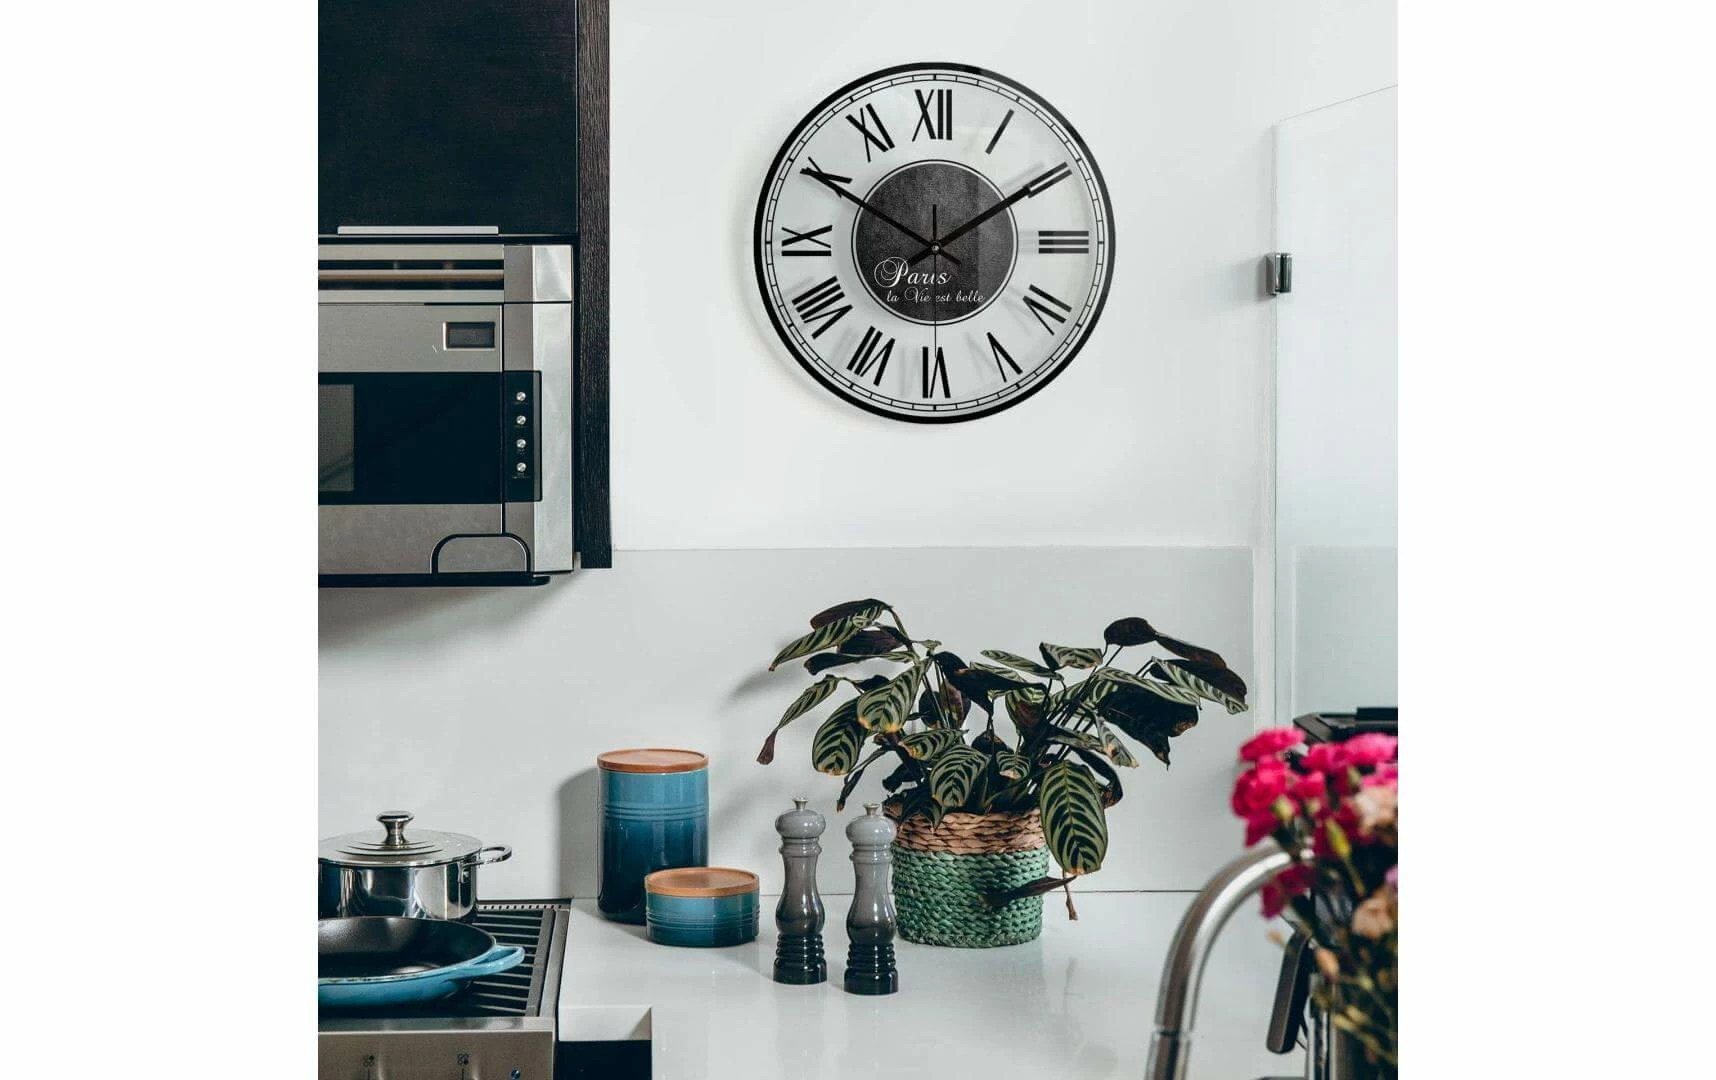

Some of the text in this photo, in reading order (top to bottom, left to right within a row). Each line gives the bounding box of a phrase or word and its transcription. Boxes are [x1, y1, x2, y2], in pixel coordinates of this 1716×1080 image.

[846, 103, 895, 162] XI
[912, 88, 952, 141] XII
[985, 109, 1014, 154] I
[781, 224, 832, 256] IX
[1038, 230, 1089, 254] III
[874, 256, 952, 288] Paris
[887, 286, 985, 303] la Vie est belle
[792, 275, 853, 339] VIII
[1023, 284, 1072, 336] IV
[847, 326, 895, 387] VII
[922, 346, 951, 399] VI
[986, 332, 1023, 383] V
